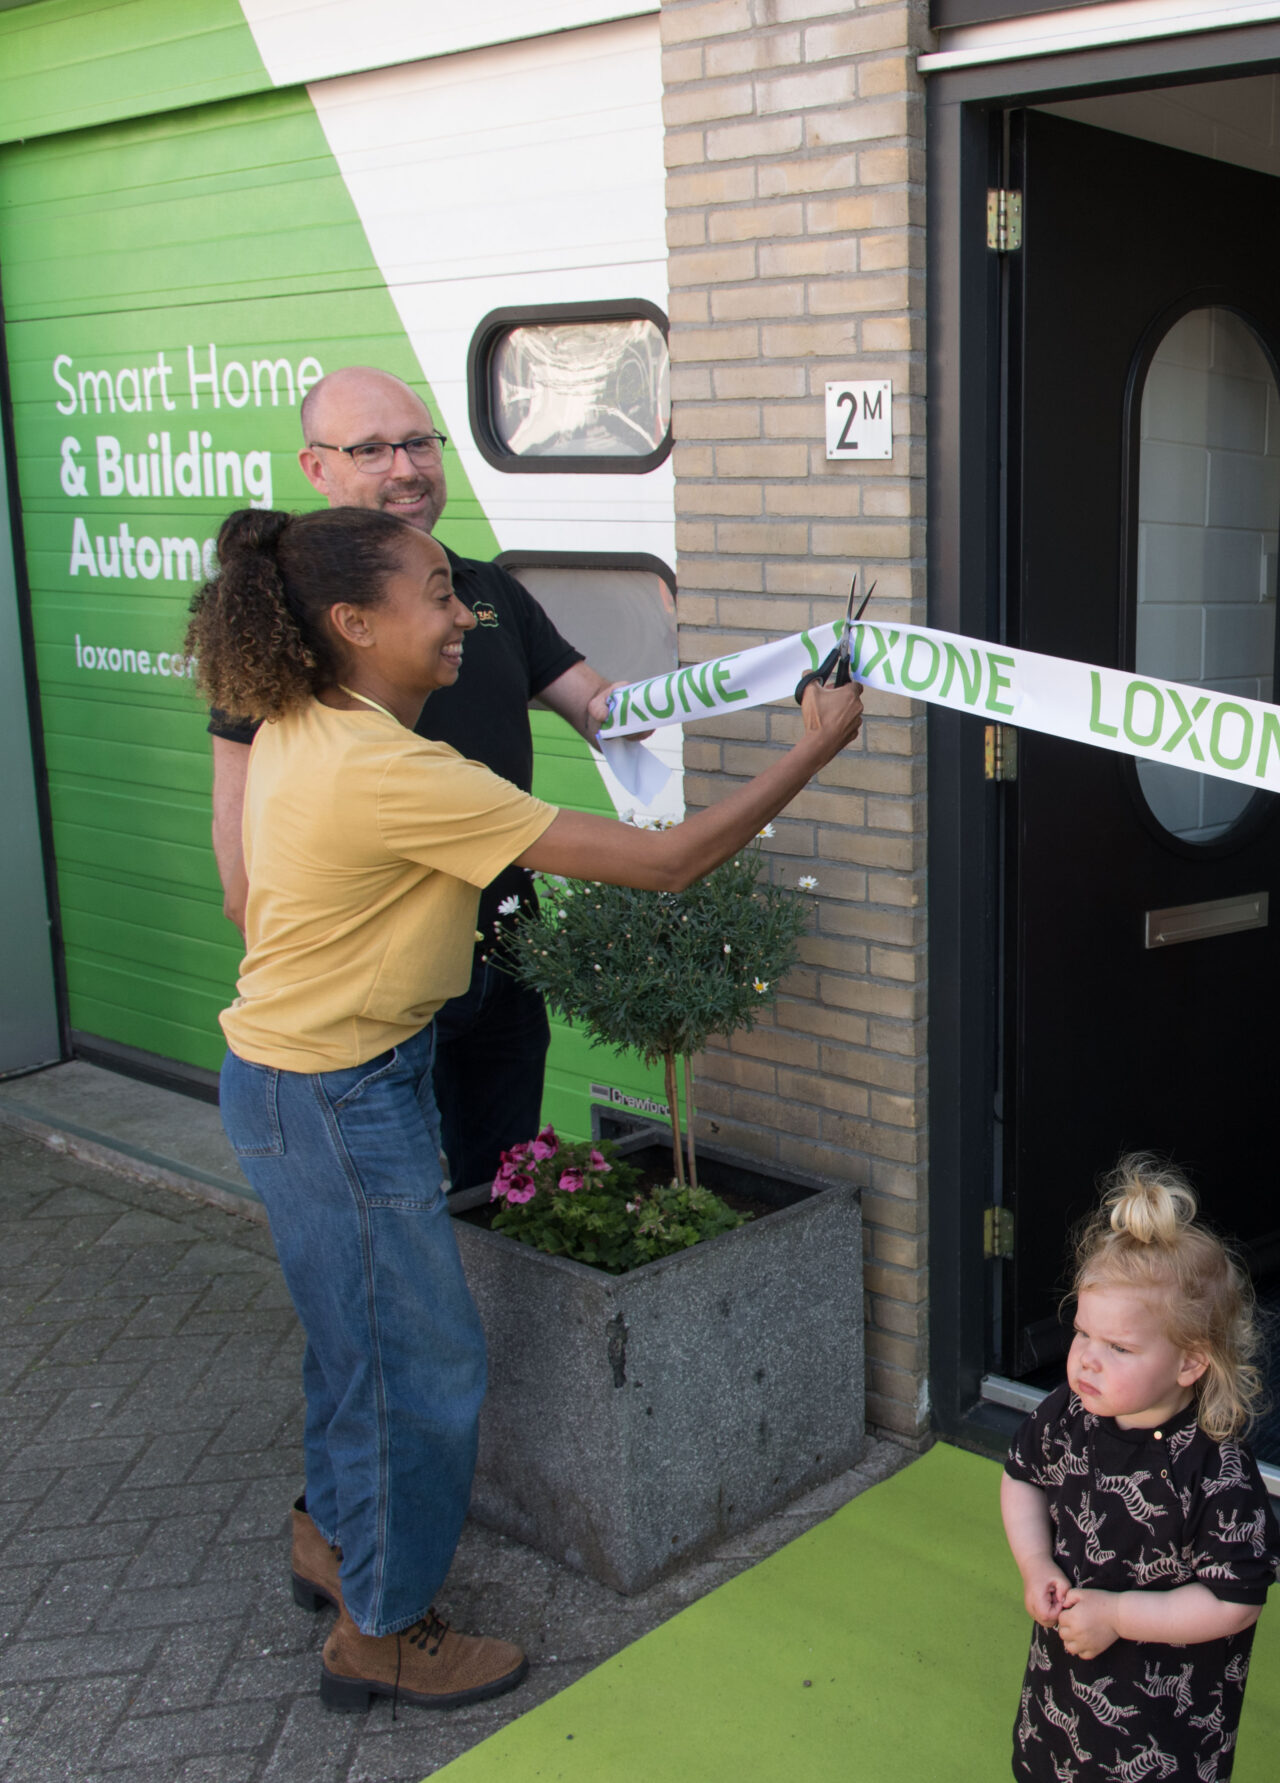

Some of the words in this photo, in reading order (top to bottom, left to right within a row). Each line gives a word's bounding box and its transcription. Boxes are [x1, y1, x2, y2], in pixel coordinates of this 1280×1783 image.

[53, 350, 176, 416] Smart
[188, 343, 325, 408] Home
[60, 436, 88, 498] &
[97, 431, 273, 509] Building
